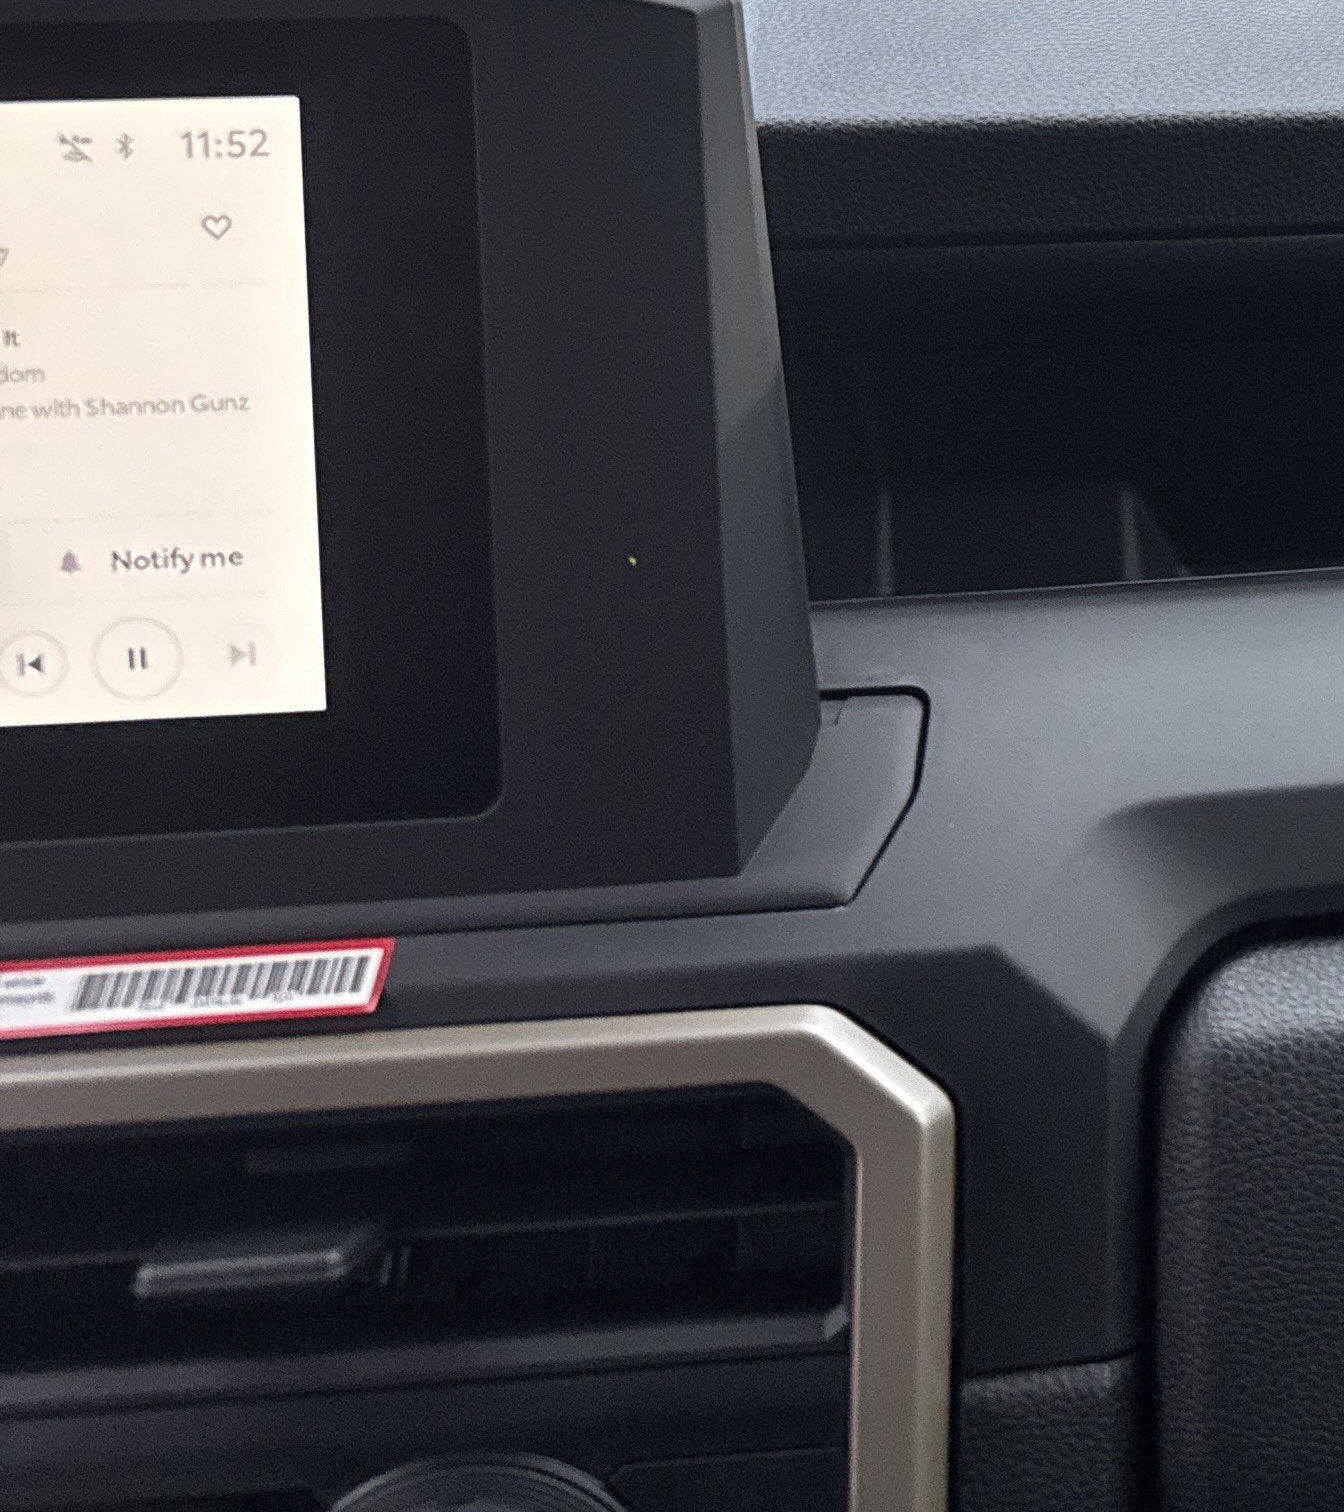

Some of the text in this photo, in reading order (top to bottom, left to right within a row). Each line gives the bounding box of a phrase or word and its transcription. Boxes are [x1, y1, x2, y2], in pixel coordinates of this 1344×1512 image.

[180, 129, 270, 158] 11:52
[30, 398, 81, 418] with
[85, 398, 186, 417] Shannon
[190, 394, 250, 412] Gunz
[111, 547, 244, 574] Notify me
